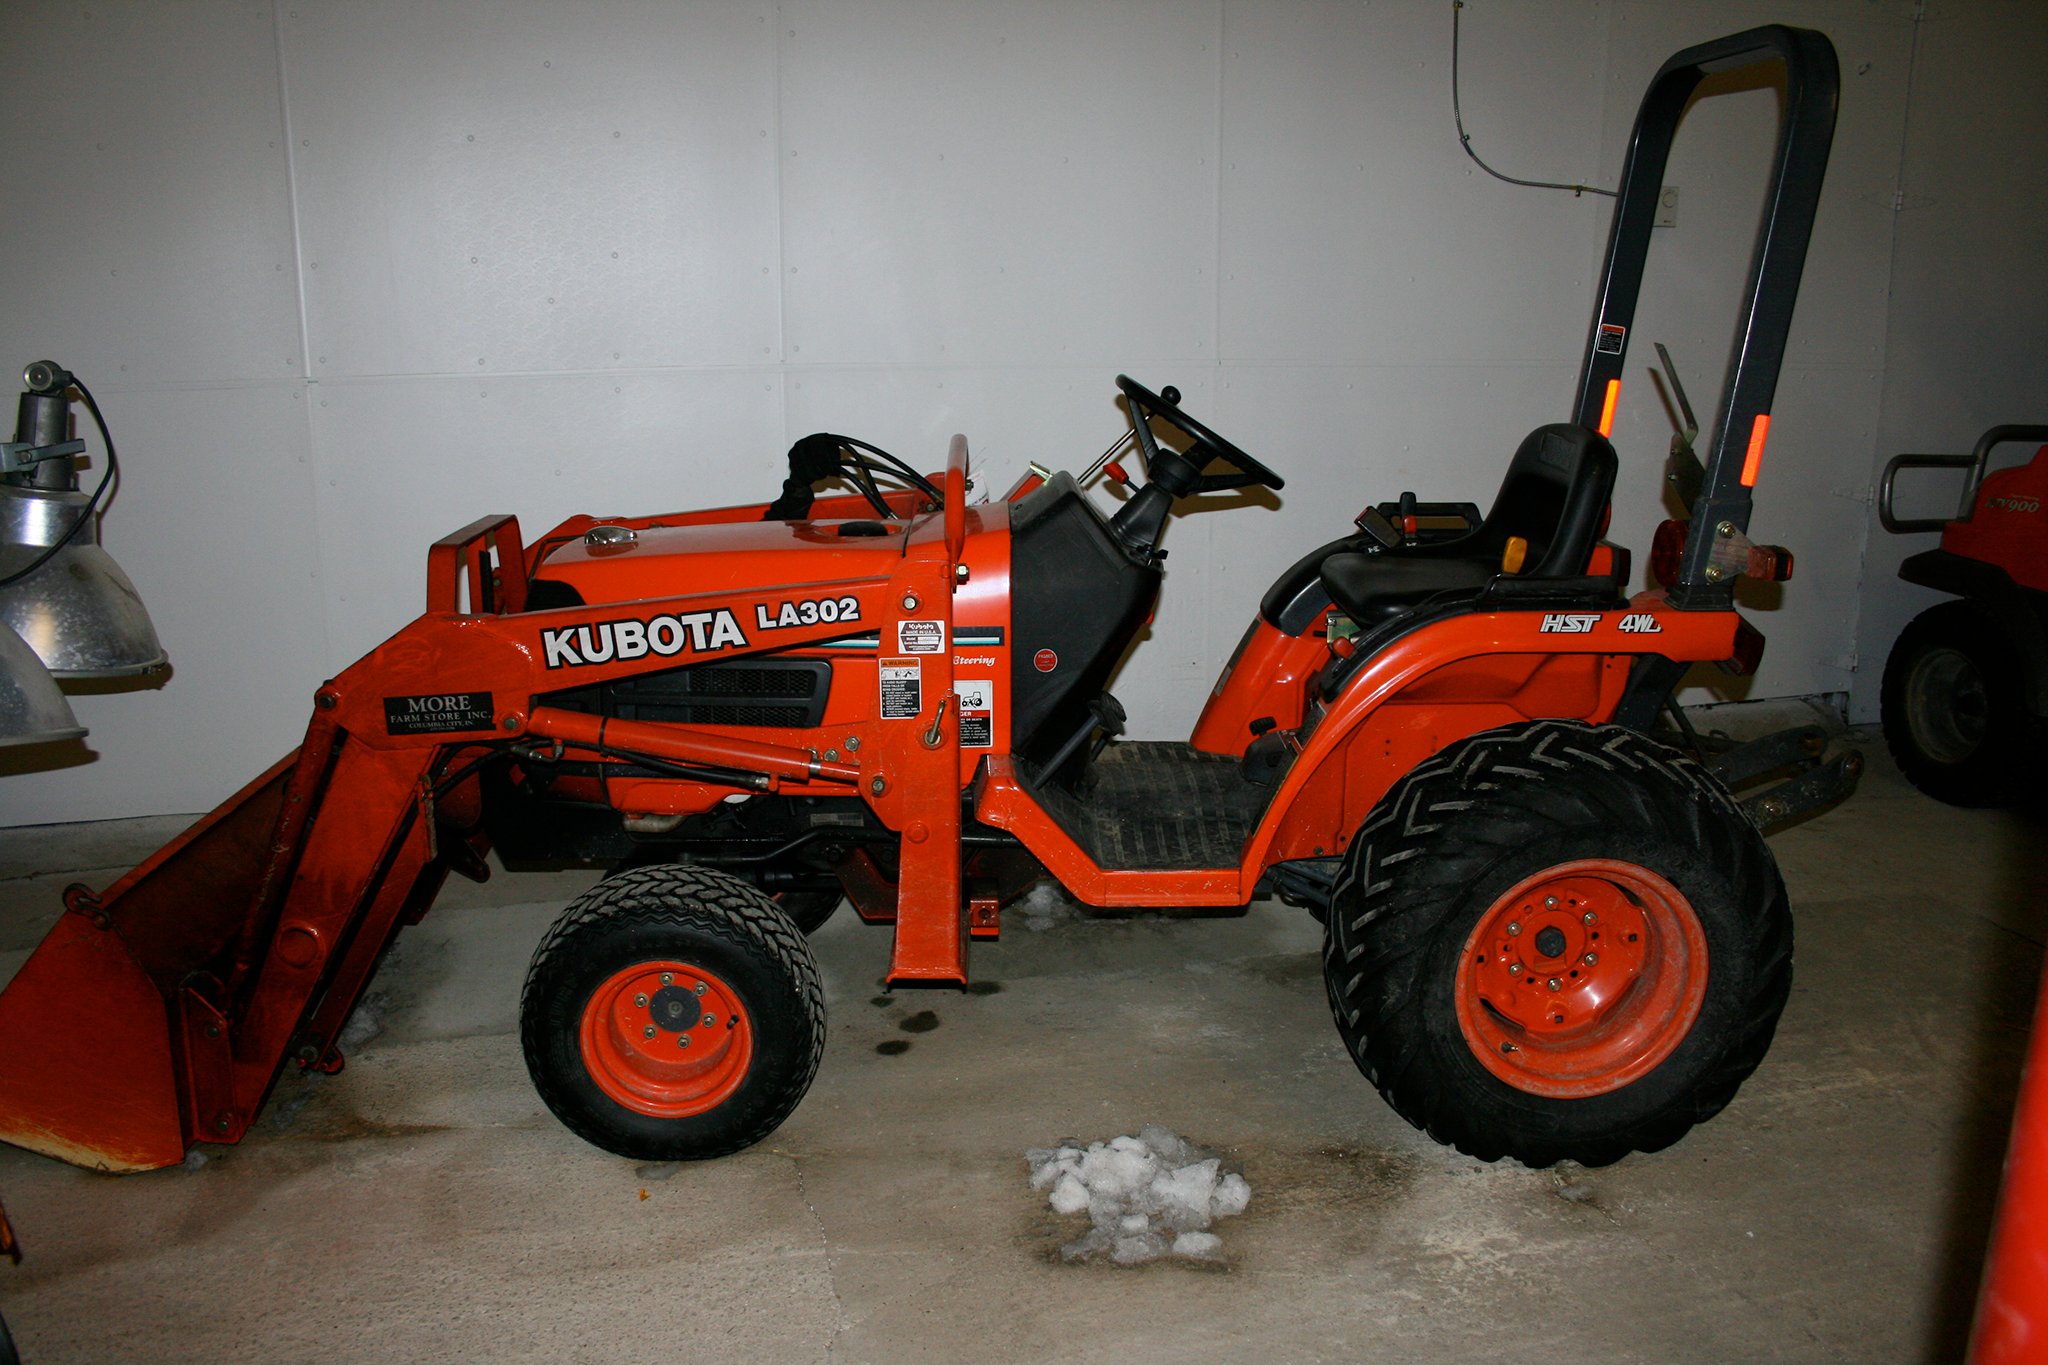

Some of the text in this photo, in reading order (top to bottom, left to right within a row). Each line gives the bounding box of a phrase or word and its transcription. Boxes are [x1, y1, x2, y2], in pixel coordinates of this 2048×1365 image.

[1539, 613, 1601, 633] HST
[541, 597, 860, 669] KUBOTA LA302
[952, 655, 996, 667] Steering
[408, 695, 472, 713] MORE
[390, 711, 492, 723] FARM STORE INC.
[408, 721, 445, 729] COLUMBIA
